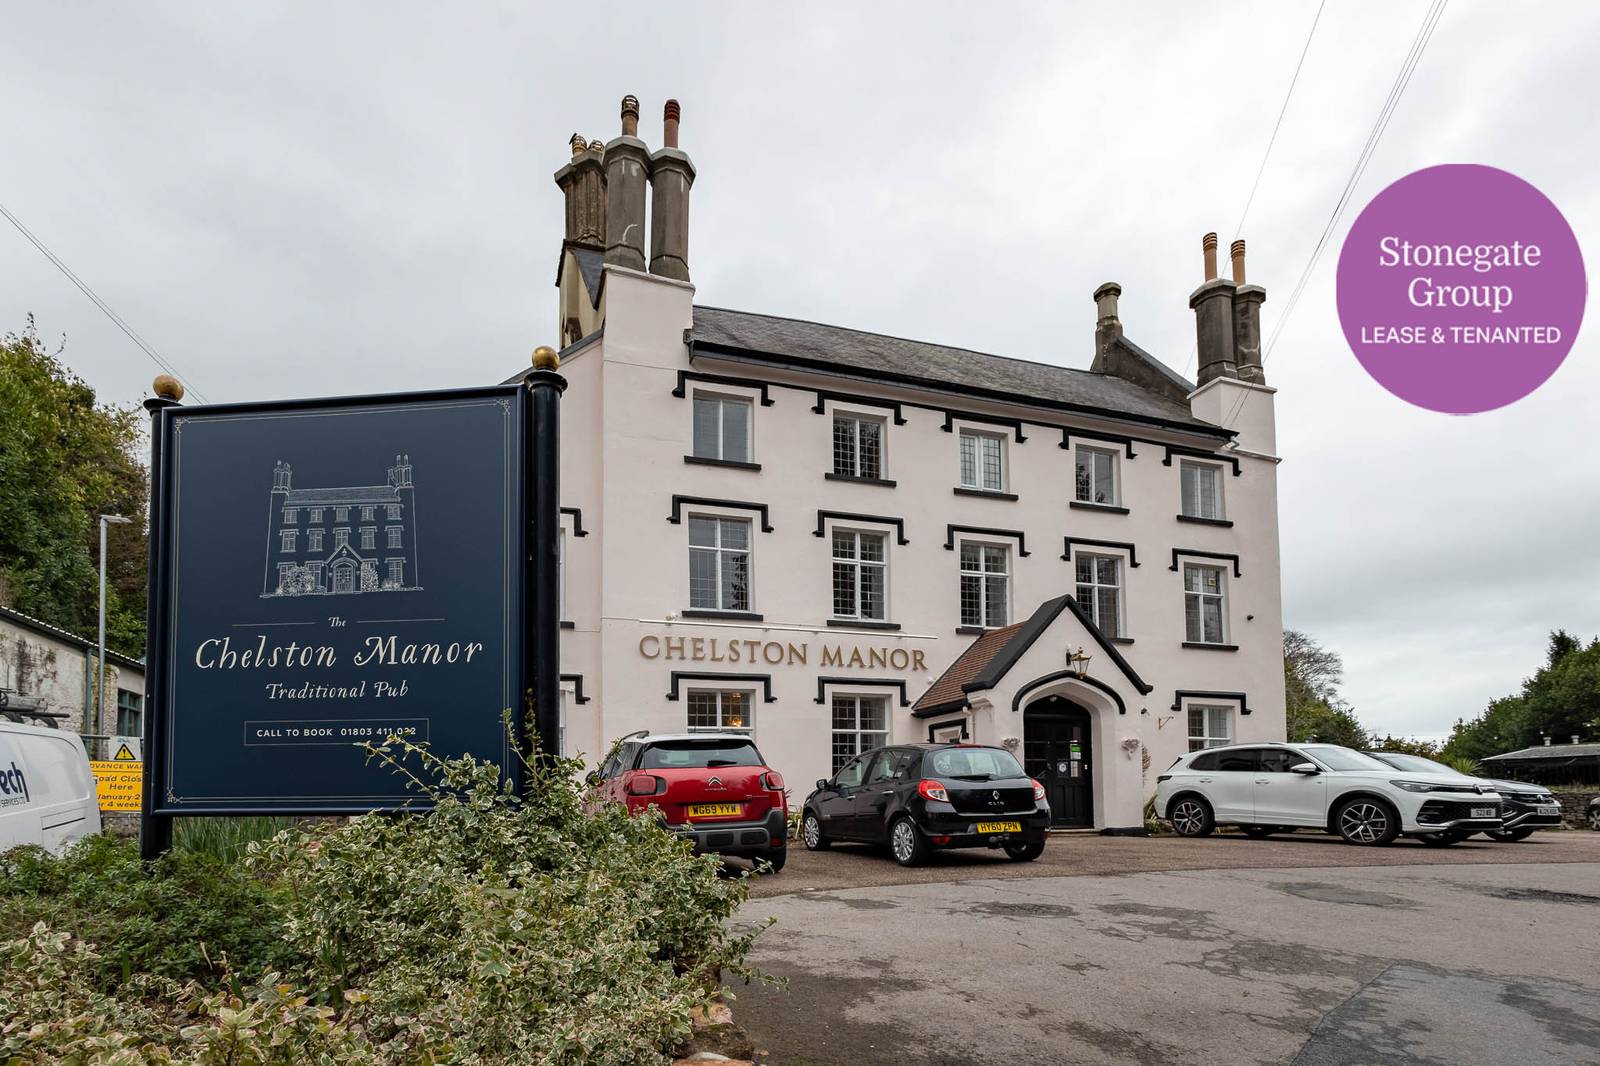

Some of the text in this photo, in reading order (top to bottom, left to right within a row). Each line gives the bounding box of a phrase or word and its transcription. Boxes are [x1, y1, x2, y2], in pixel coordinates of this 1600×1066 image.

[327, 616, 347, 628] The
[195, 635, 483, 670] Chelston Manor
[639, 635, 928, 671] CHELSTON MANOR
[265, 679, 409, 700] Traditional Pub
[256, 729, 282, 737] CALL
[286, 729, 300, 737] TO
[304, 728, 333, 736] BOOK
[340, 727, 372, 736] 01803
[376, 727, 394, 736] 411
[692, 806, 717, 815] WG69
[980, 822, 1002, 832] HY60
